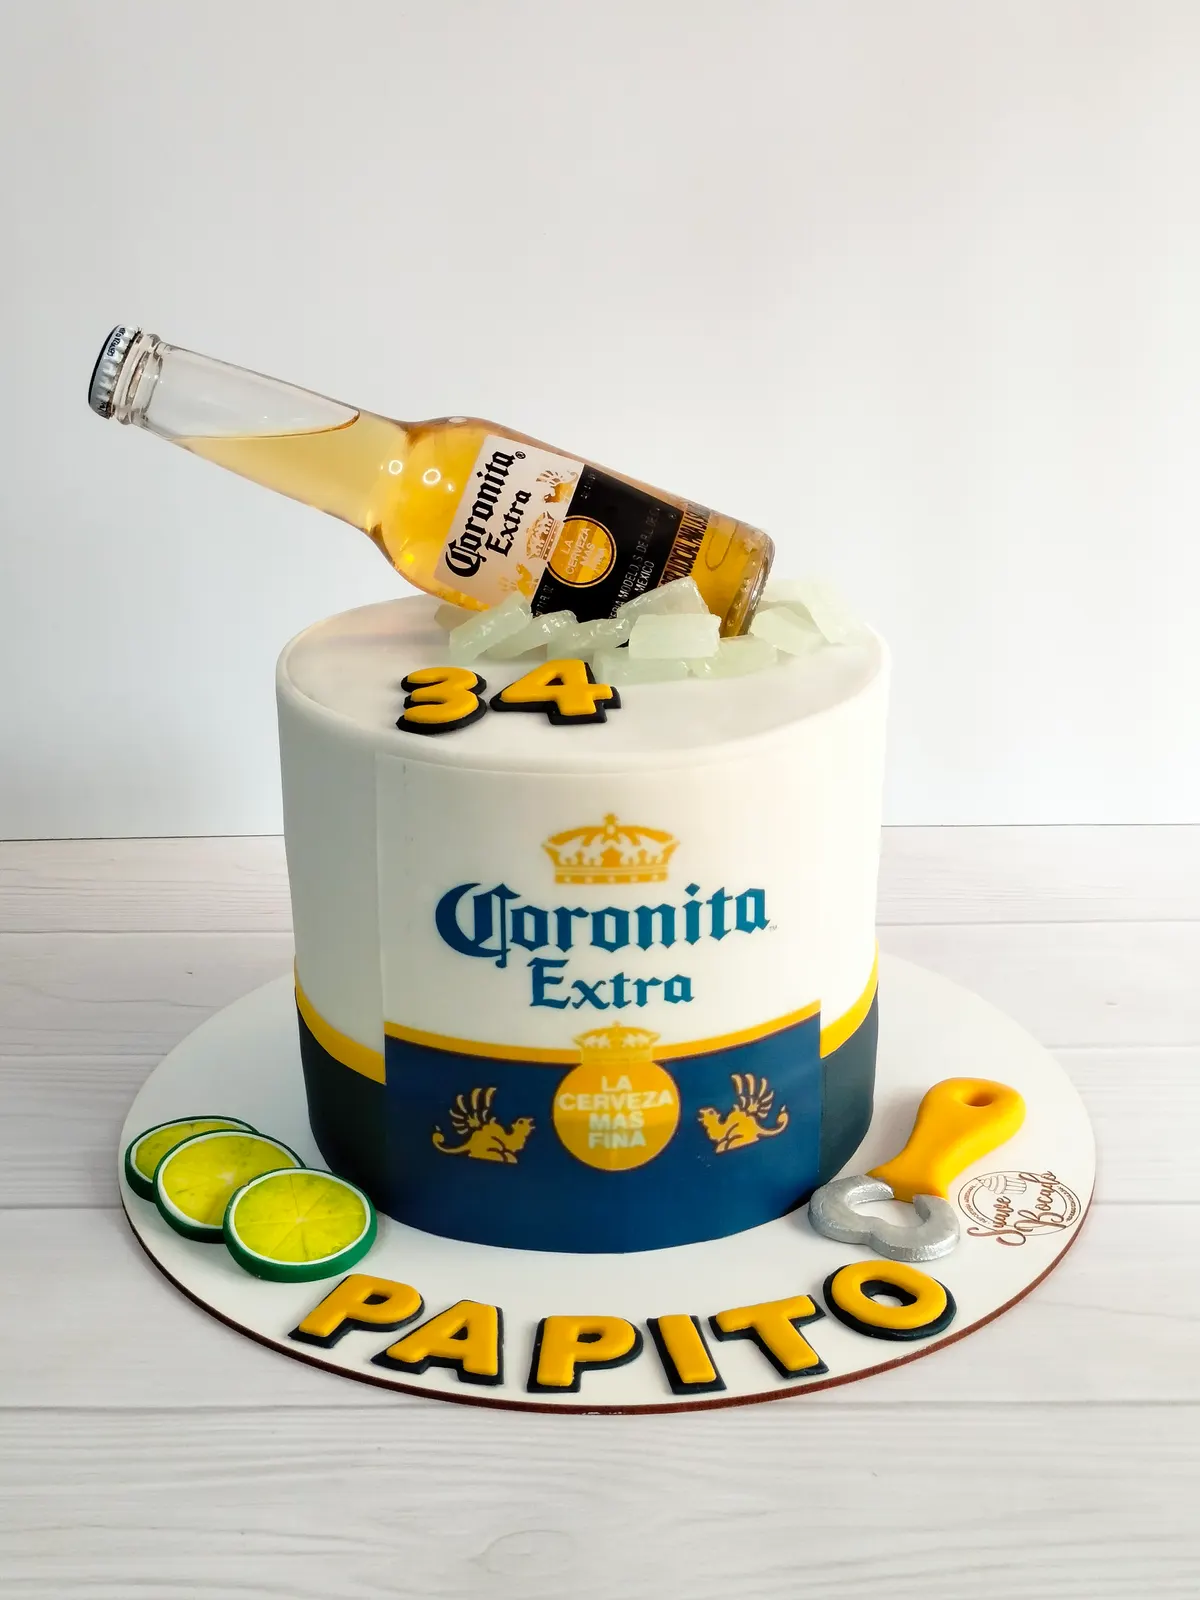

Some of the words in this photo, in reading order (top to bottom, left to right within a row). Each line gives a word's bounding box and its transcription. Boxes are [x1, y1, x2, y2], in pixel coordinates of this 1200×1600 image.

[445, 450, 516, 577] Coronita
[485, 490, 532, 557] Extra
[561, 539, 574, 555] LA
[565, 527, 591, 575] CERVEZA
[396, 659, 622, 734] 34
[435, 882, 770, 968] Coronita
[526, 956, 695, 1010] Extra
[558, 1089, 674, 1112] CERVEZA
[601, 1075, 633, 1093] LA
[587, 1129, 647, 1150] FINA
[588, 1111, 645, 1131] MAS
[967, 1196, 1026, 1246] Suave
[289, 1260, 956, 1394] PAPITO
